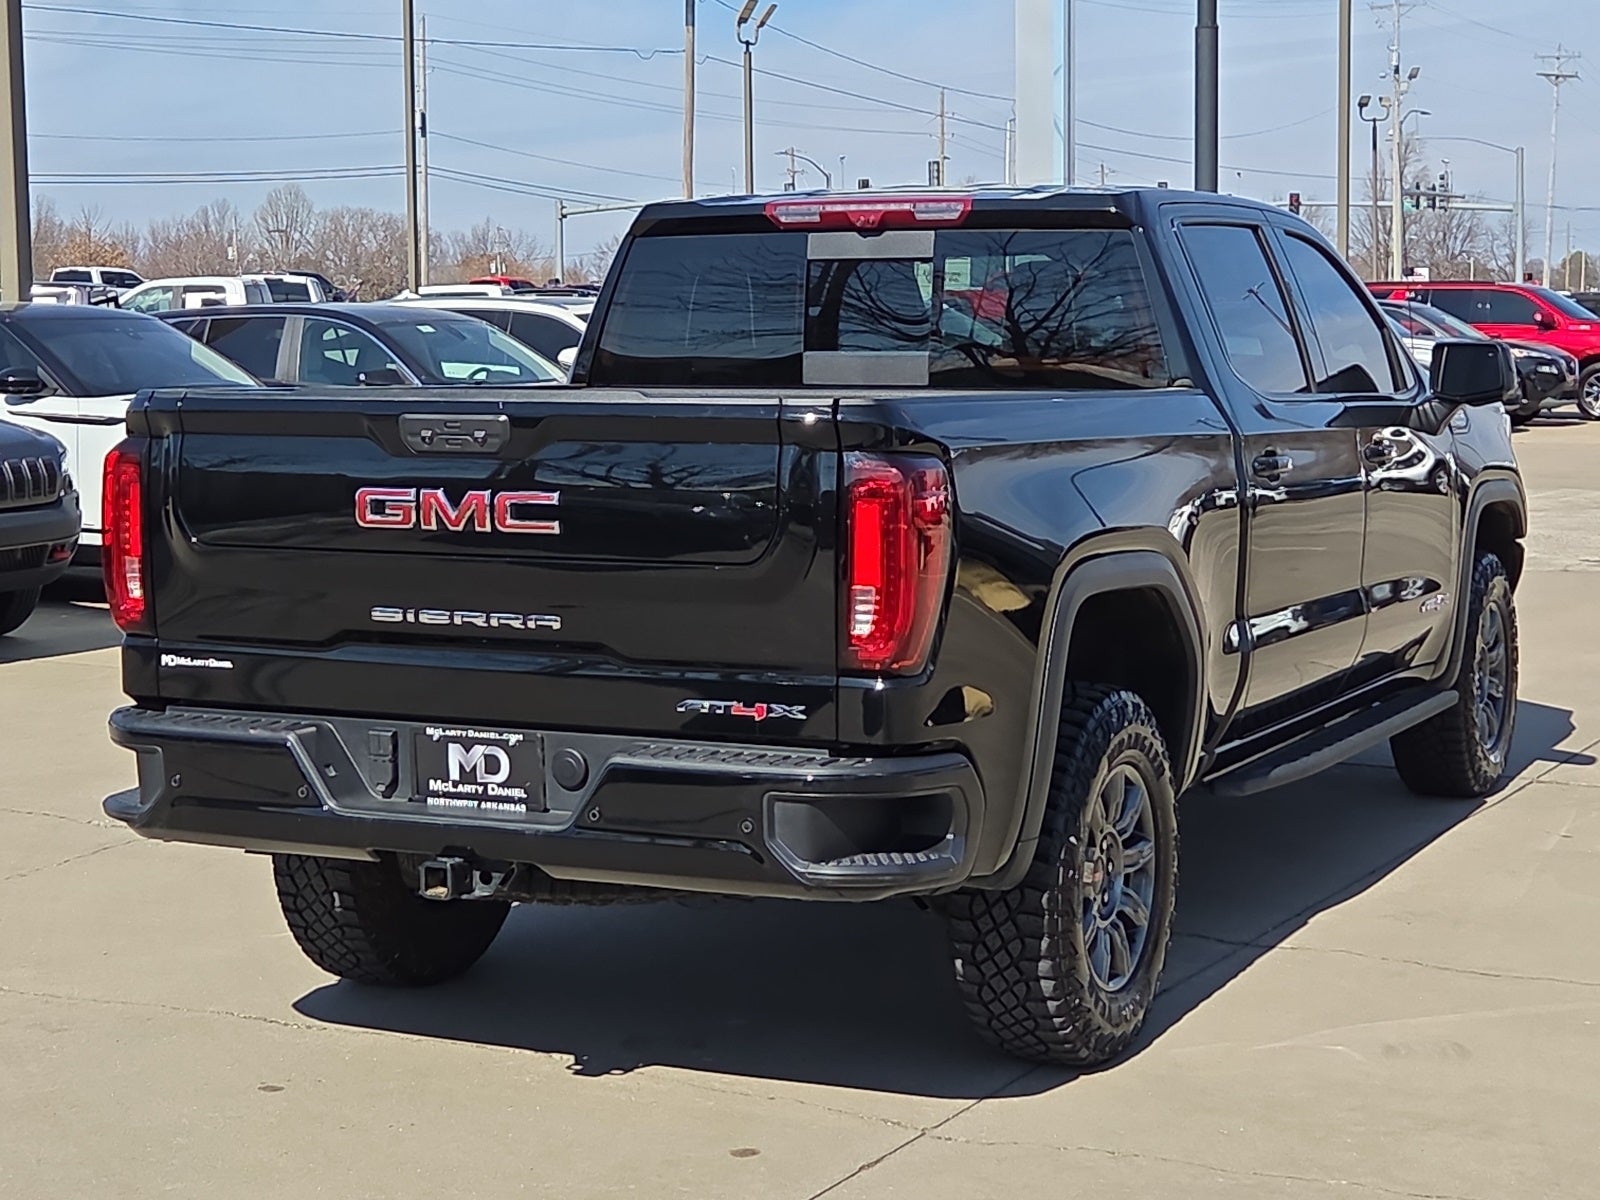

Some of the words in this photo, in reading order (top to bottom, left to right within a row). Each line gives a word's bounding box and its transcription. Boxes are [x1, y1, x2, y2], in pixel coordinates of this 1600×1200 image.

[355, 487, 561, 534] GMC
[370, 606, 562, 630] SIERRA
[676, 699, 808, 721] AT4X
[447, 742, 511, 784] MD
